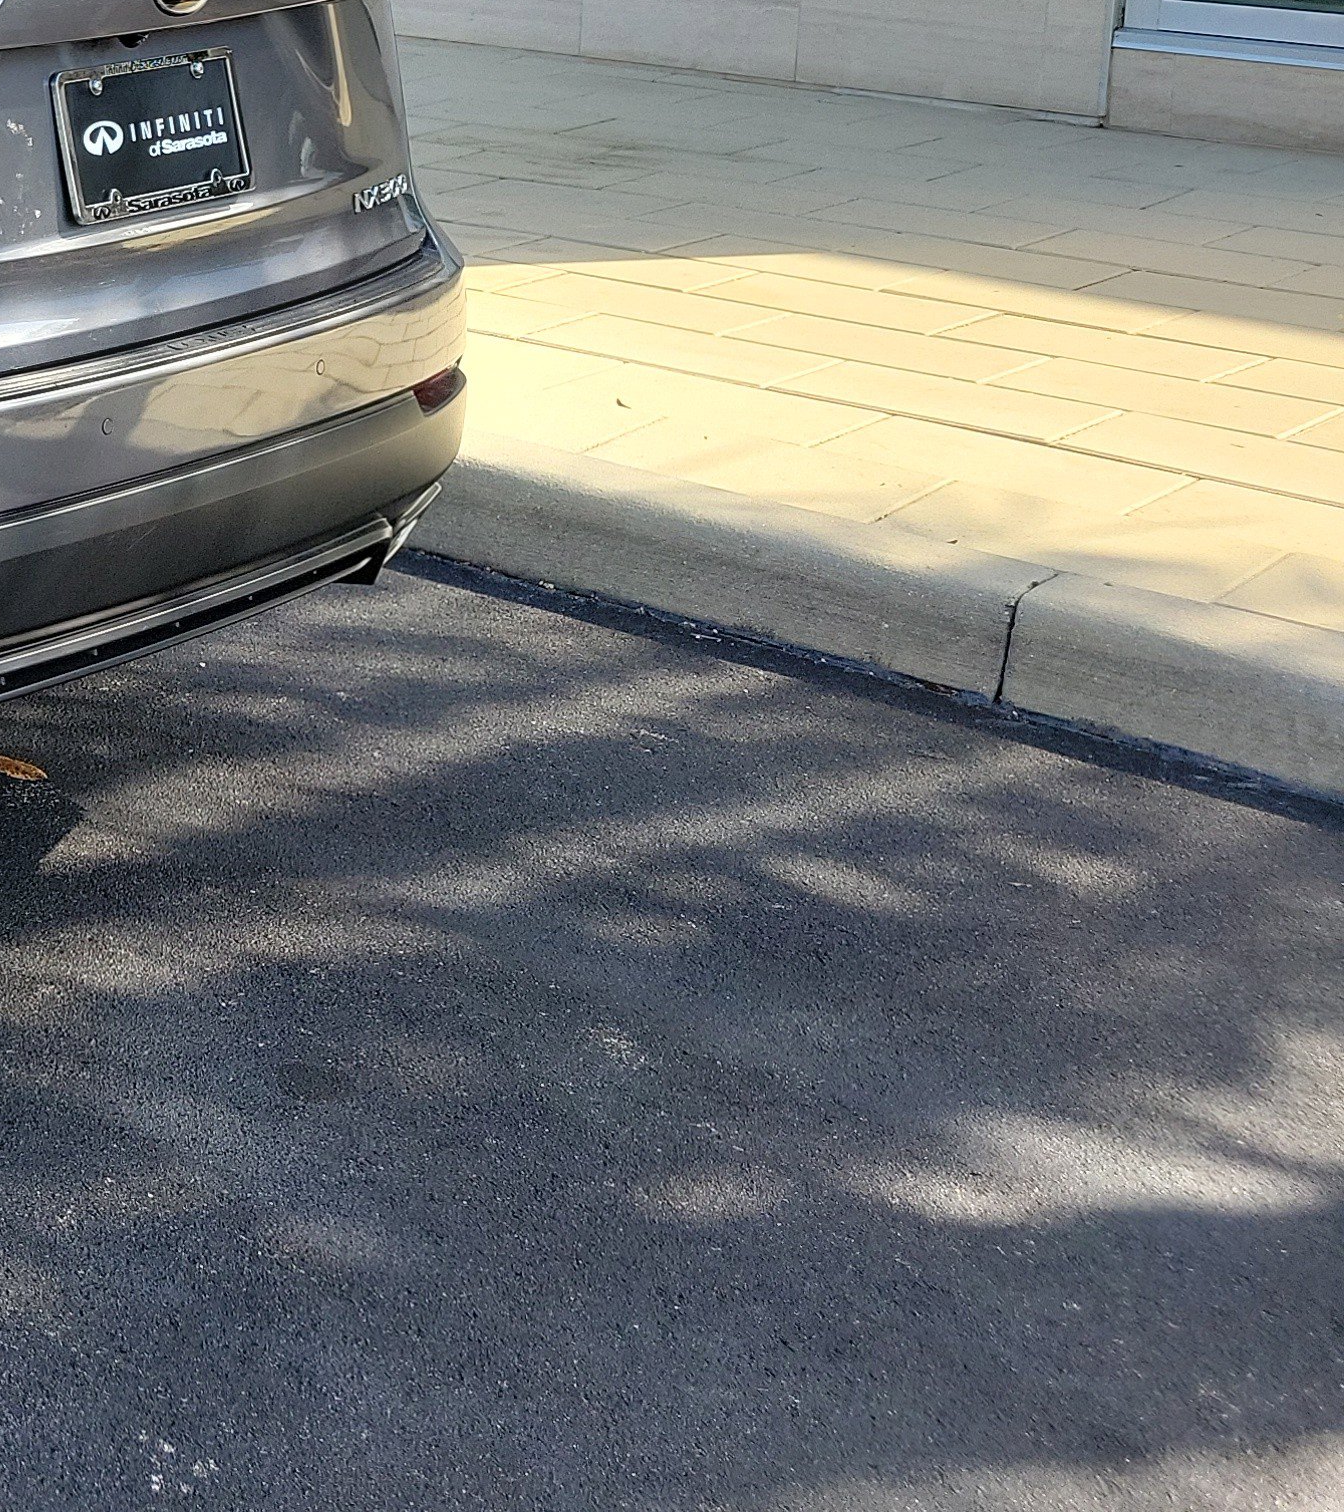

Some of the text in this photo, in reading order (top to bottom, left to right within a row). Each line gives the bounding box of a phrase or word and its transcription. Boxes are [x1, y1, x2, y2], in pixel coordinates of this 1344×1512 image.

[129, 106, 224, 142] INFINITI
[149, 130, 228, 157] of Sarasota
[126, 186, 212, 213] Sarasota
